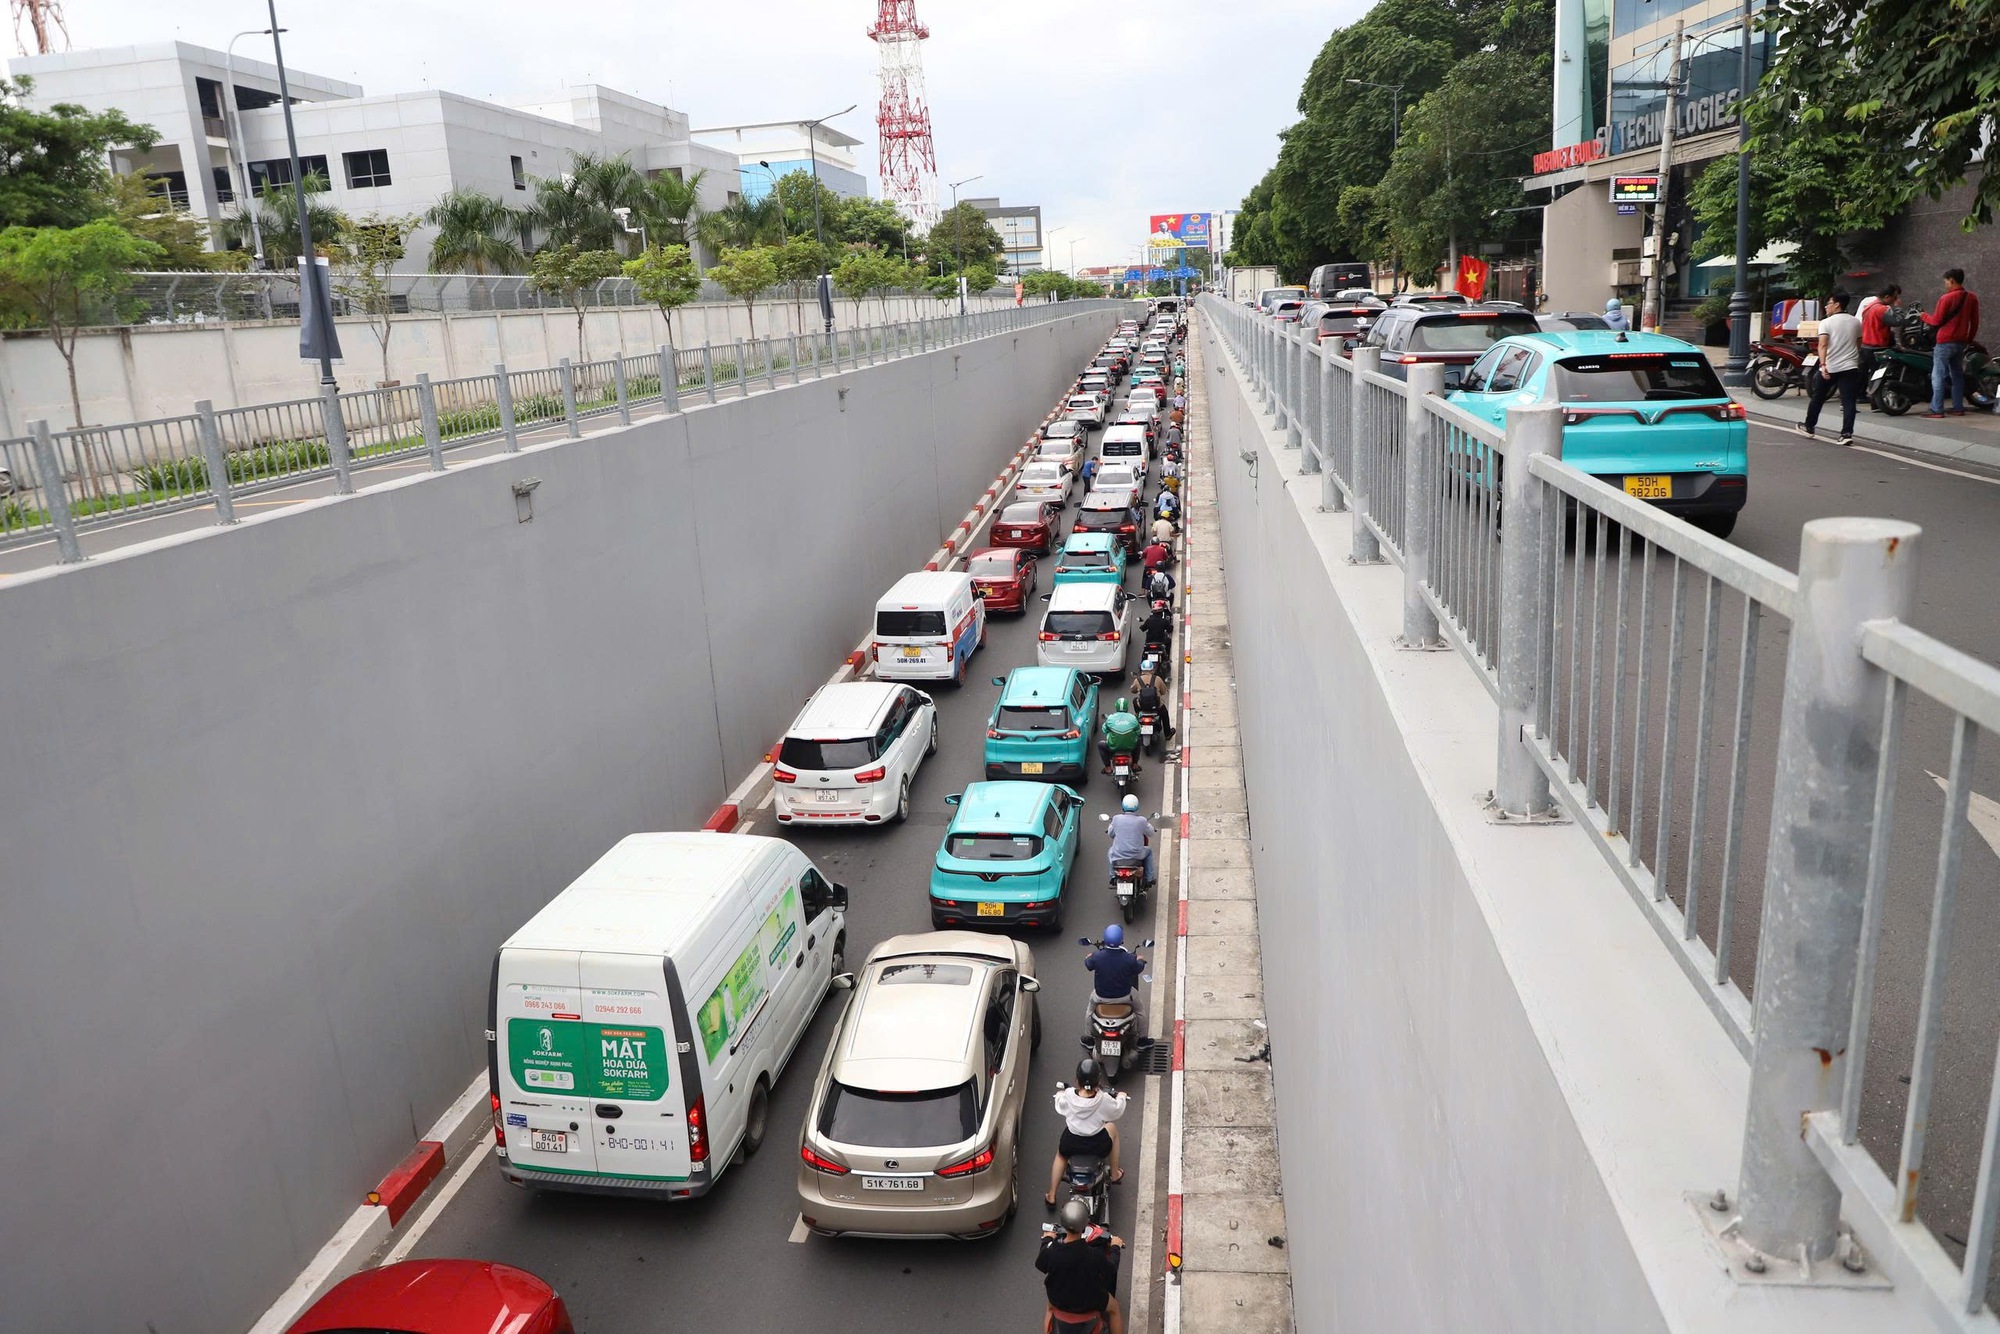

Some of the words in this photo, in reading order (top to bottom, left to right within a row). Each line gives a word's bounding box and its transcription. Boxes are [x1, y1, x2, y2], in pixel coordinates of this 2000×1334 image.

[1619, 88, 1740, 152] TECHNLOGIES
[1638, 477, 1658, 487] 50H
[1630, 488, 1667, 497] 382.06
[541, 1001, 552, 1009] 243
[601, 1037, 646, 1059] MẬT
[603, 1059, 624, 1069] HOA
[626, 1058, 647, 1070] DỪA
[603, 1068, 648, 1079] SOKFARM
[541, 1133, 557, 1142] 84D
[536, 1142, 563, 1150] 001.41
[867, 1179, 919, 1188] 51K-761.68
